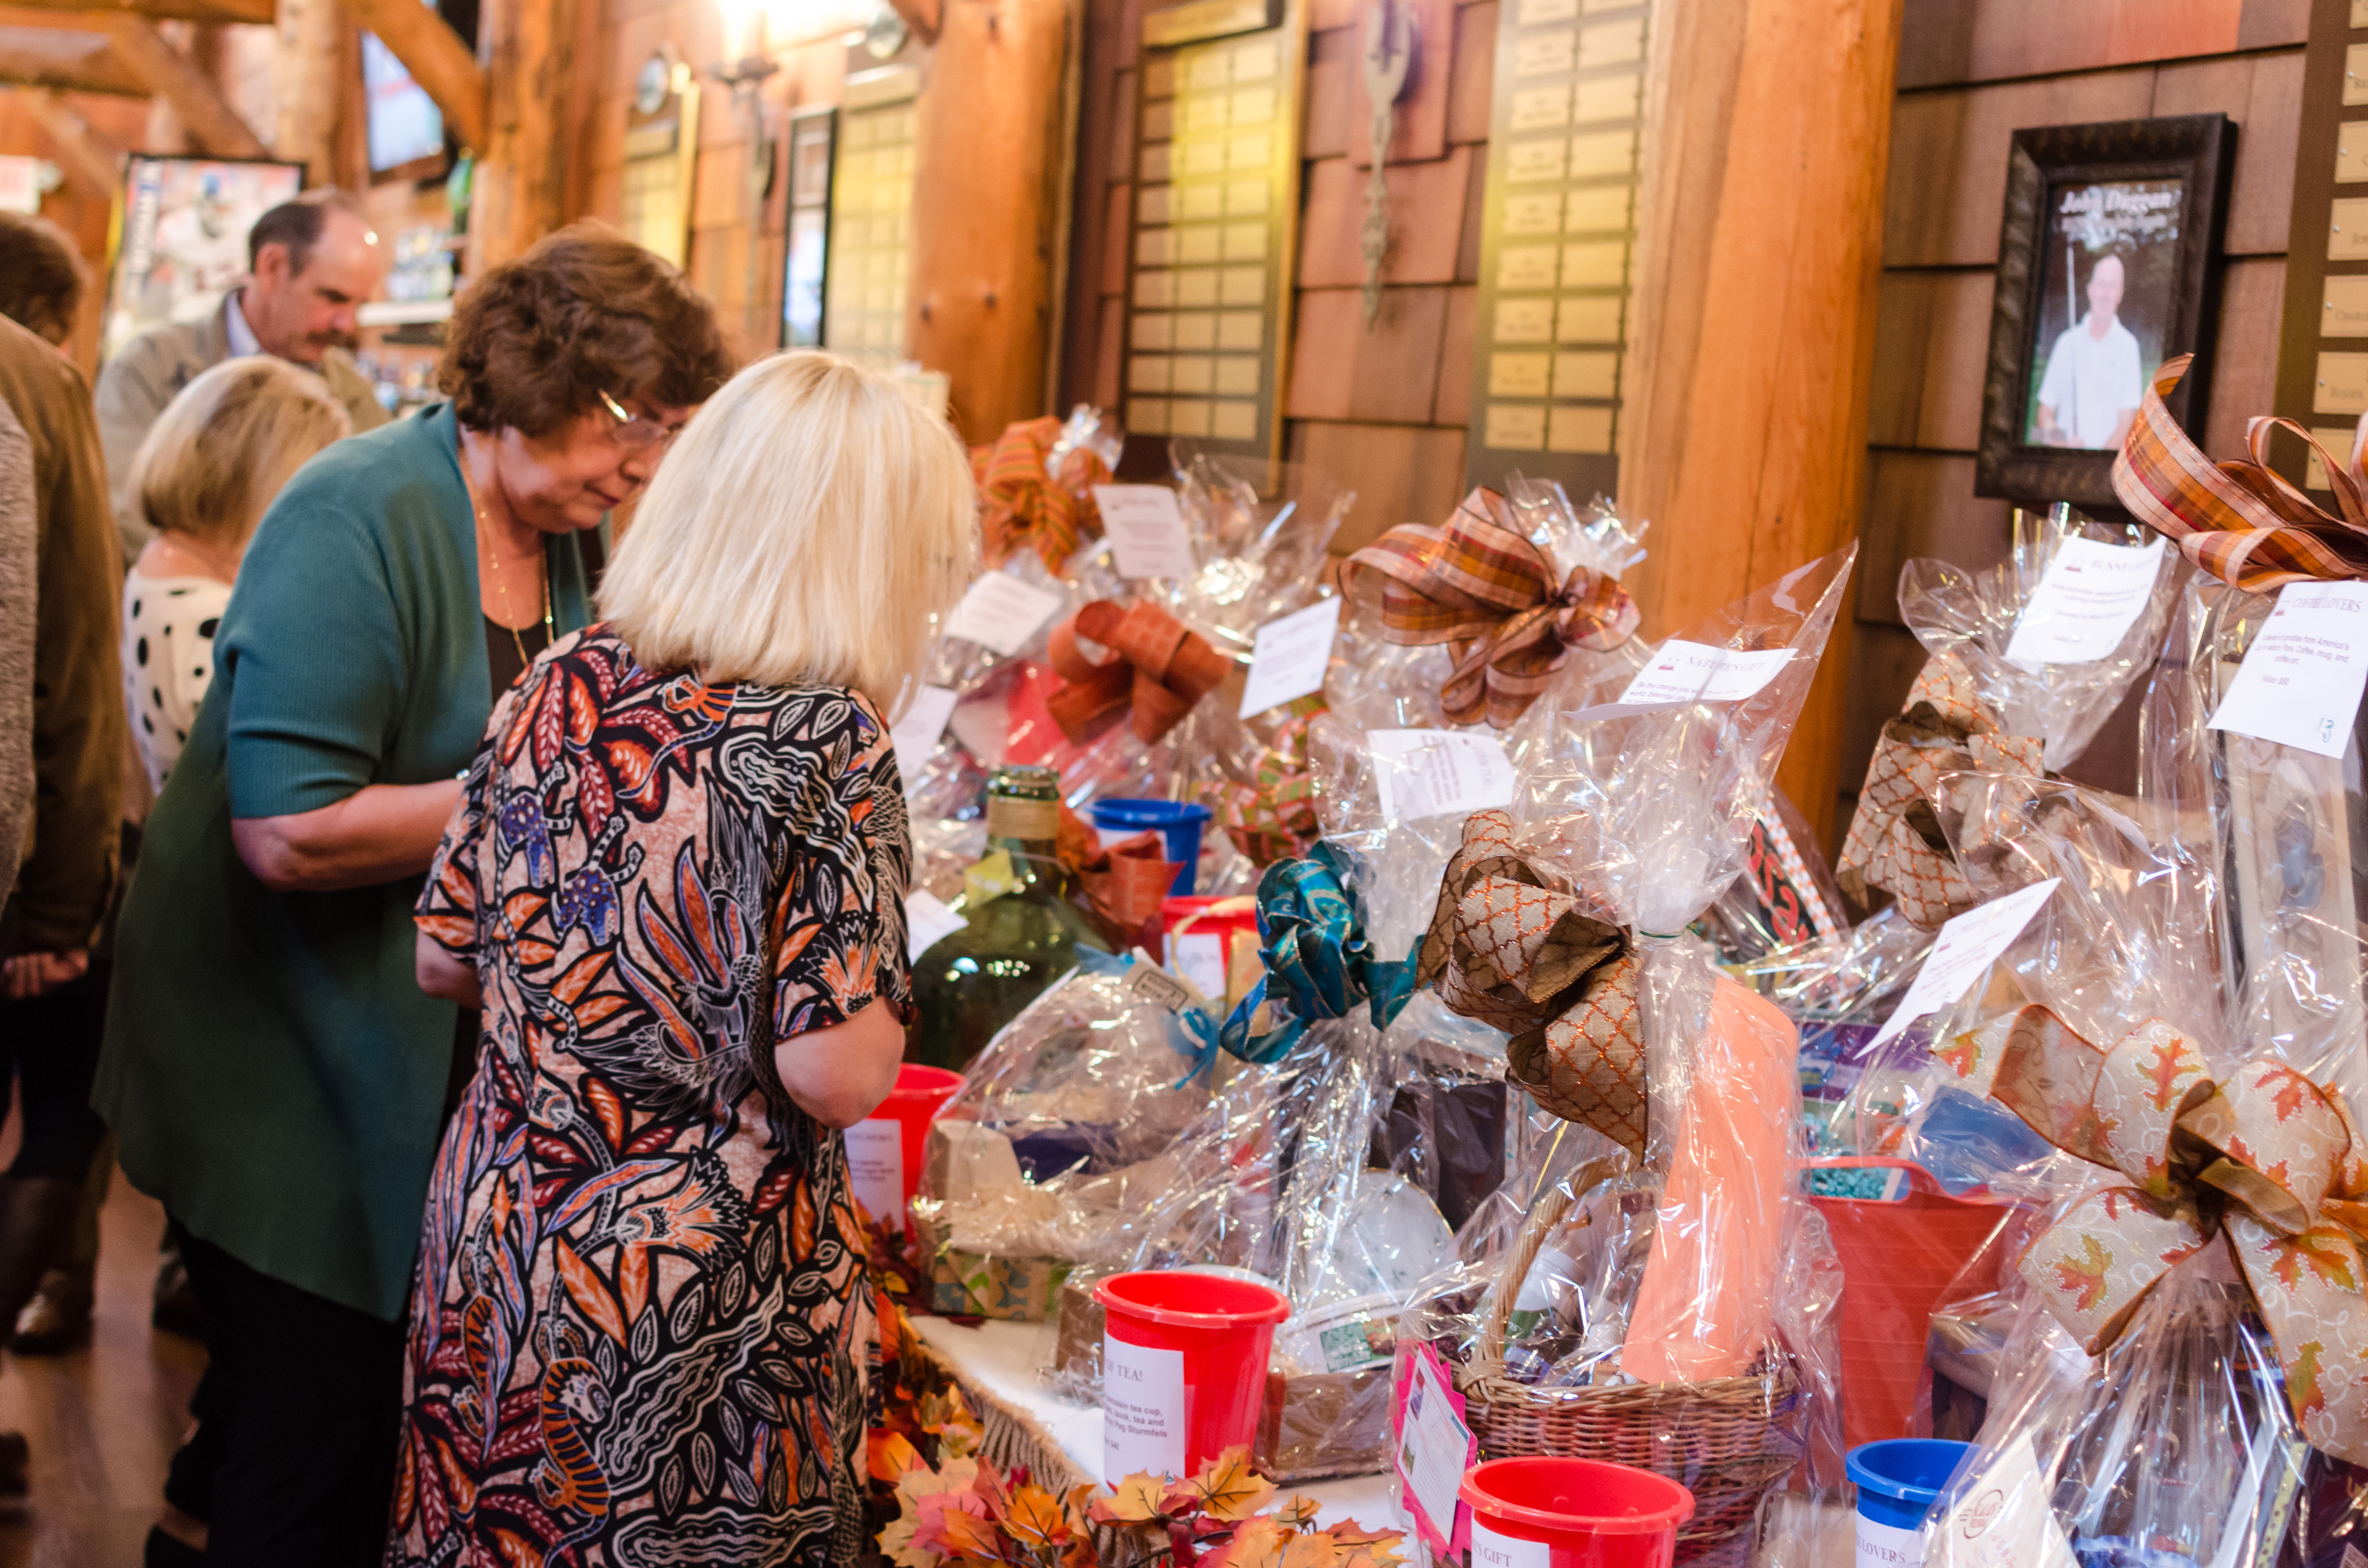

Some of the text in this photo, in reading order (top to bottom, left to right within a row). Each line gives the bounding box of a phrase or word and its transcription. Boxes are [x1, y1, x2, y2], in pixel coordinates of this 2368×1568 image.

[2322, 598, 2363, 613] LOVERS
[2304, 635, 2317, 644] from
[2318, 638, 2350, 651] America's
[1685, 656, 1767, 672] NATURE'S GIFT
[2335, 654, 2351, 663] and
[1656, 684, 1677, 692] change
[1117, 1364, 1143, 1382] TEA!
[1129, 1404, 1142, 1413] tea
[1144, 1408, 1163, 1417] cup,
[1133, 1416, 1146, 1424] tea
[1147, 1419, 1165, 1427] and
[1128, 1425, 1168, 1438] Sturmfels
[1484, 1547, 1513, 1568] GIFT
[1862, 1538, 1906, 1564] LOVERS
